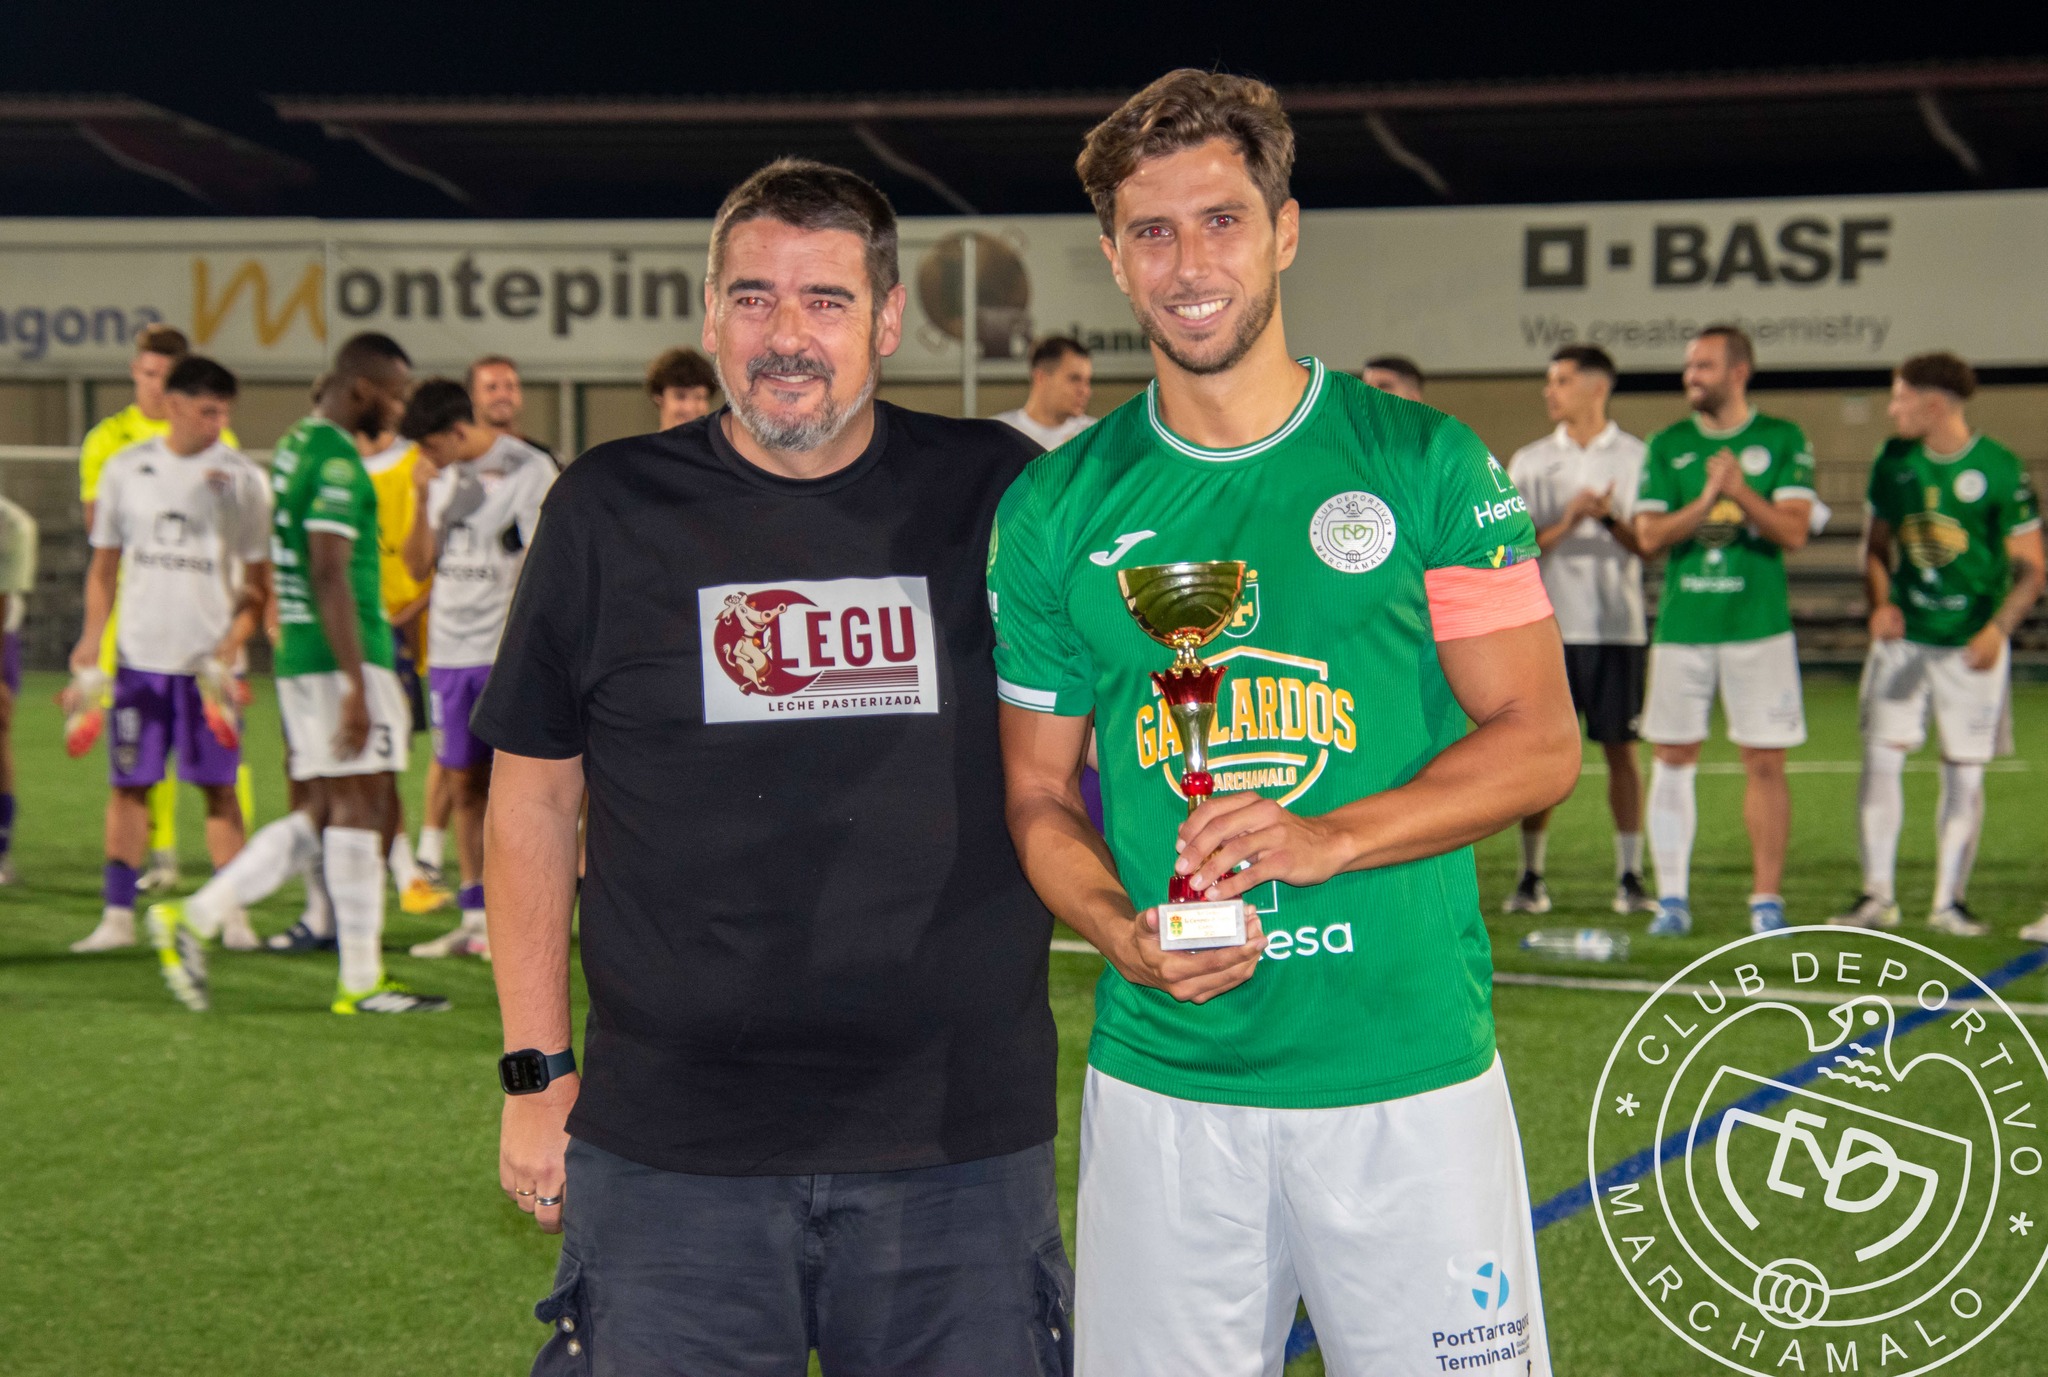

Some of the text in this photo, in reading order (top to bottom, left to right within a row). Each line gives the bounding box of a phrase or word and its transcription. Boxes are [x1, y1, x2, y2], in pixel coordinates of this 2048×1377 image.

[1653, 217, 1892, 287] BASF
[192, 248, 706, 347] Montepin
[0, 303, 163, 361] gona
[1733, 310, 1893, 353] hemistry
[1313, 494, 1391, 526] CLUB DEPORTIVO
[1316, 545, 1388, 571] MARCHAMALO
[767, 606, 917, 668] LEGU
[768, 696, 922, 712] LECHE PASTERIZADA
[1136, 676, 1357, 769] GALARDOS
[1213, 766, 1298, 792] ARCHAMALO
[1258, 922, 1354, 962] esa
[1436, 1342, 1516, 1372] Terminal
